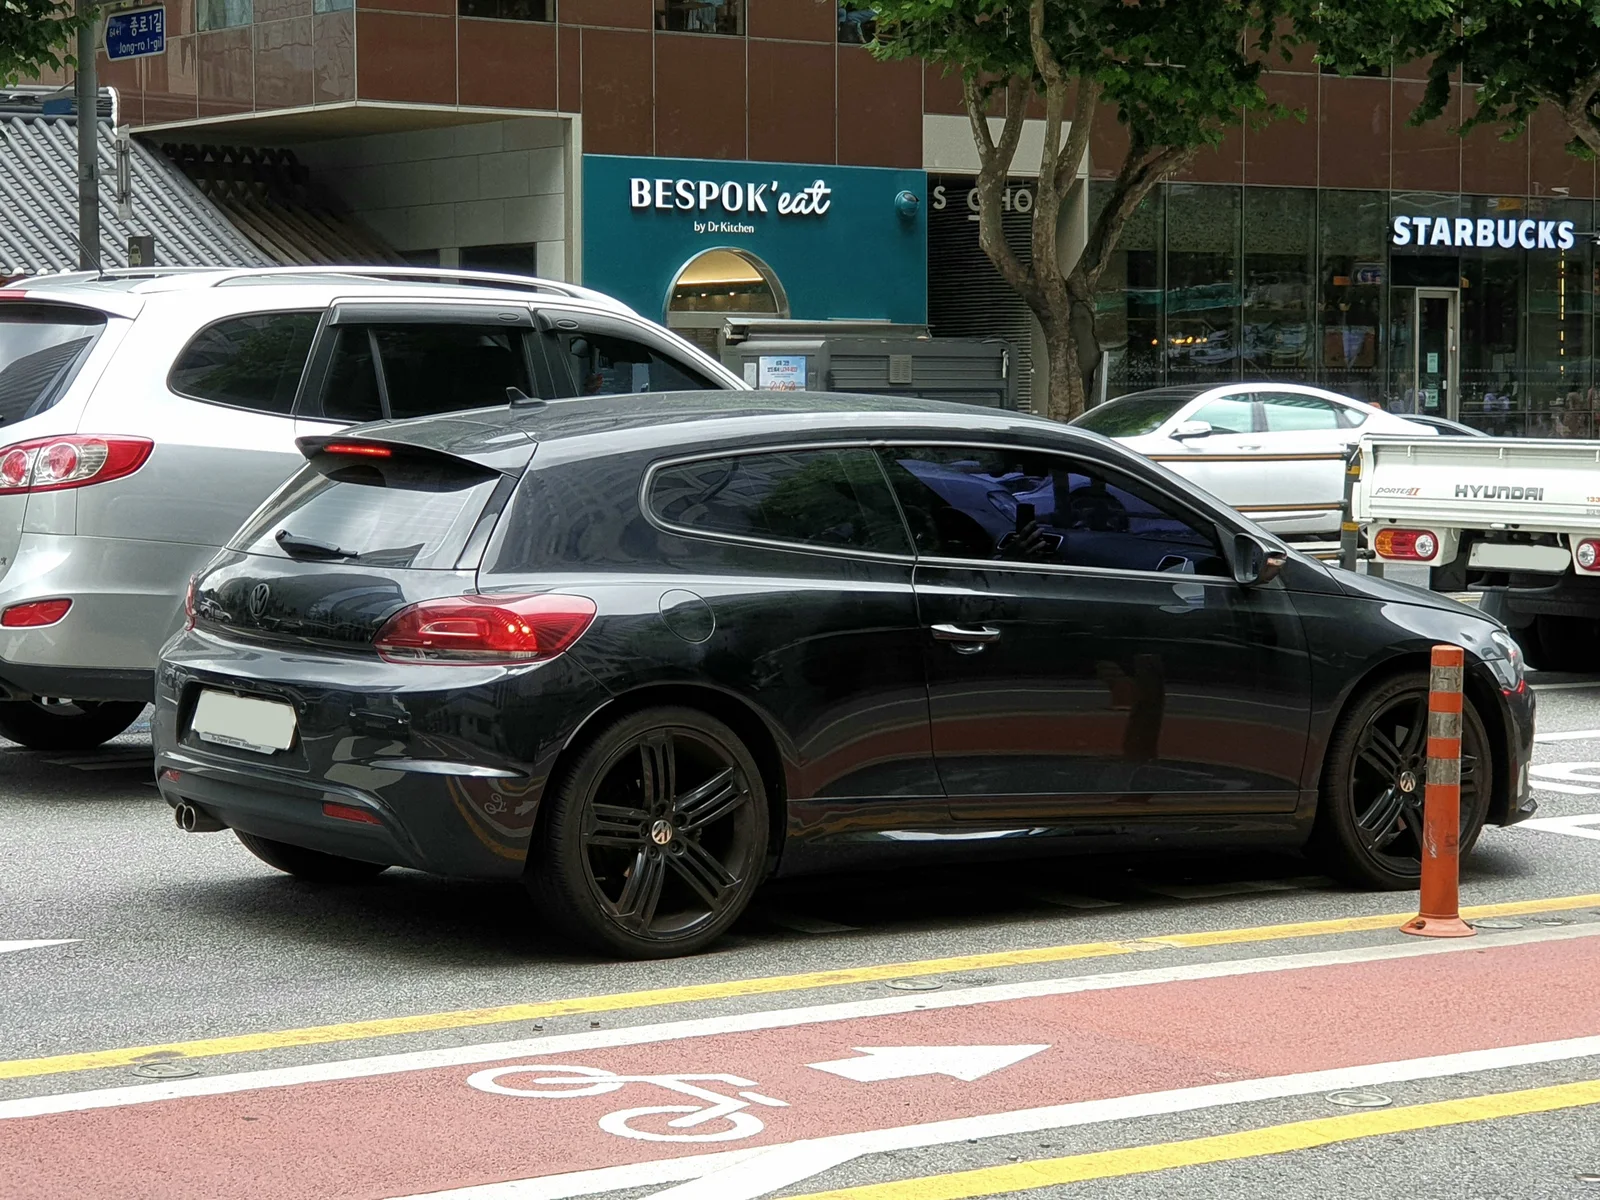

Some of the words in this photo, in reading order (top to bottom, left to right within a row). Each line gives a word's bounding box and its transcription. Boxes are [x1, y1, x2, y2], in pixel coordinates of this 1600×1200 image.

[130, 11, 161, 36] 종로1길
[119, 42, 145, 54] Jong-ro
[147, 36, 162, 51] 1-gil
[694, 221, 706, 234] by
[708, 221, 720, 232] Dr
[720, 222, 755, 233] Kitchen
[1393, 215, 1575, 250] STARBUCKS
[1454, 484, 1544, 501] HYUNDAI
